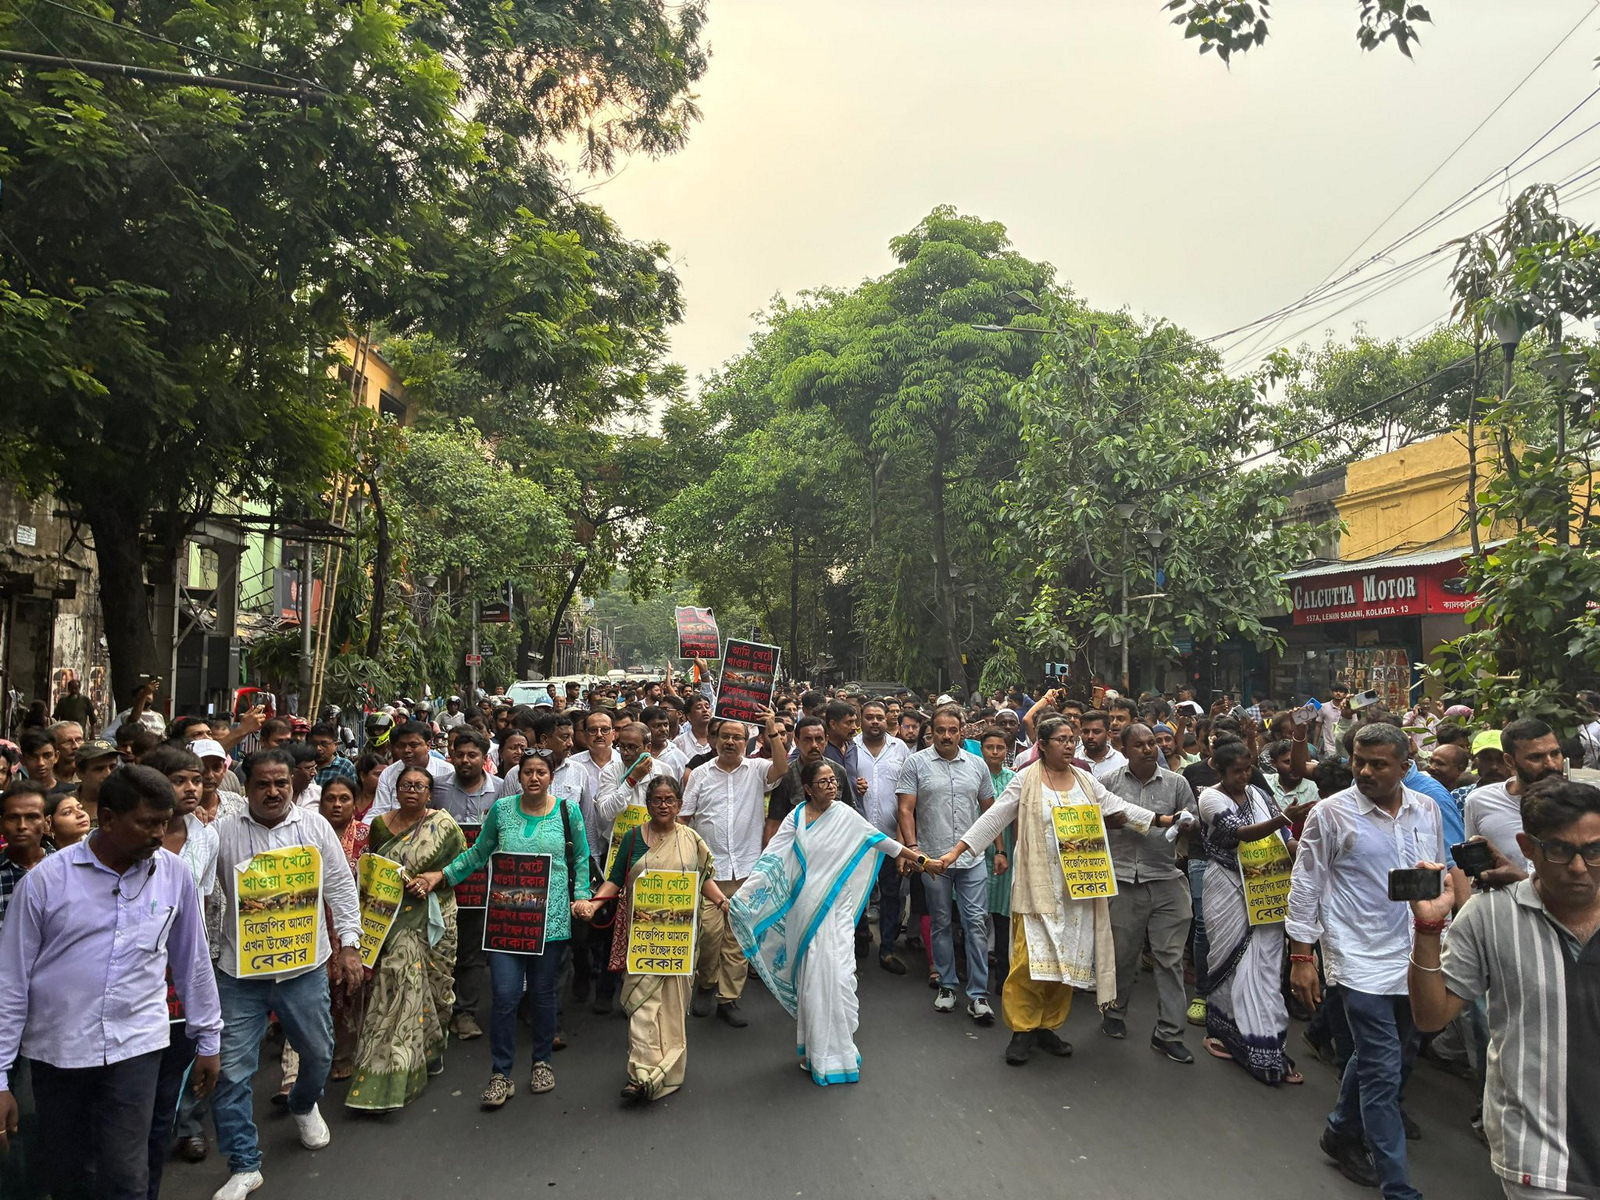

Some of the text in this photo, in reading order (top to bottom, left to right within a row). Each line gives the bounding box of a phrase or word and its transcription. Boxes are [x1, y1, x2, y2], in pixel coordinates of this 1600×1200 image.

[1294, 575, 1416, 610] CALCUTTA MOTOR
[1322, 612, 1340, 620] LENIN
[1340, 610, 1365, 619] SARANI,
[1366, 607, 1395, 616] KOLKATA
[1401, 605, 1409, 613] 13
[722, 707, 758, 721] বেকা
[1058, 808, 1079, 822] আমি
[1058, 824, 1082, 835] খাওয়া
[249, 851, 312, 872] আমি খেটে
[243, 871, 315, 890] খাওয়া হকার
[640, 874, 690, 891] আমি খেটে
[1071, 881, 1108, 895] বেকার
[637, 892, 692, 906] খাওয়া হকার
[1256, 905, 1288, 920] বেকা
[244, 915, 313, 936] বিজেপির আমলে
[243, 940, 263, 952] এখন
[295, 931, 313, 947] হওয়া
[634, 926, 689, 942] বিজেপির আমলে
[491, 936, 537, 950] বেকার
[631, 944, 647, 954] এখন
[672, 945, 689, 957] হওয়া
[251, 947, 307, 969] বেকার
[636, 957, 684, 970] বেকার
